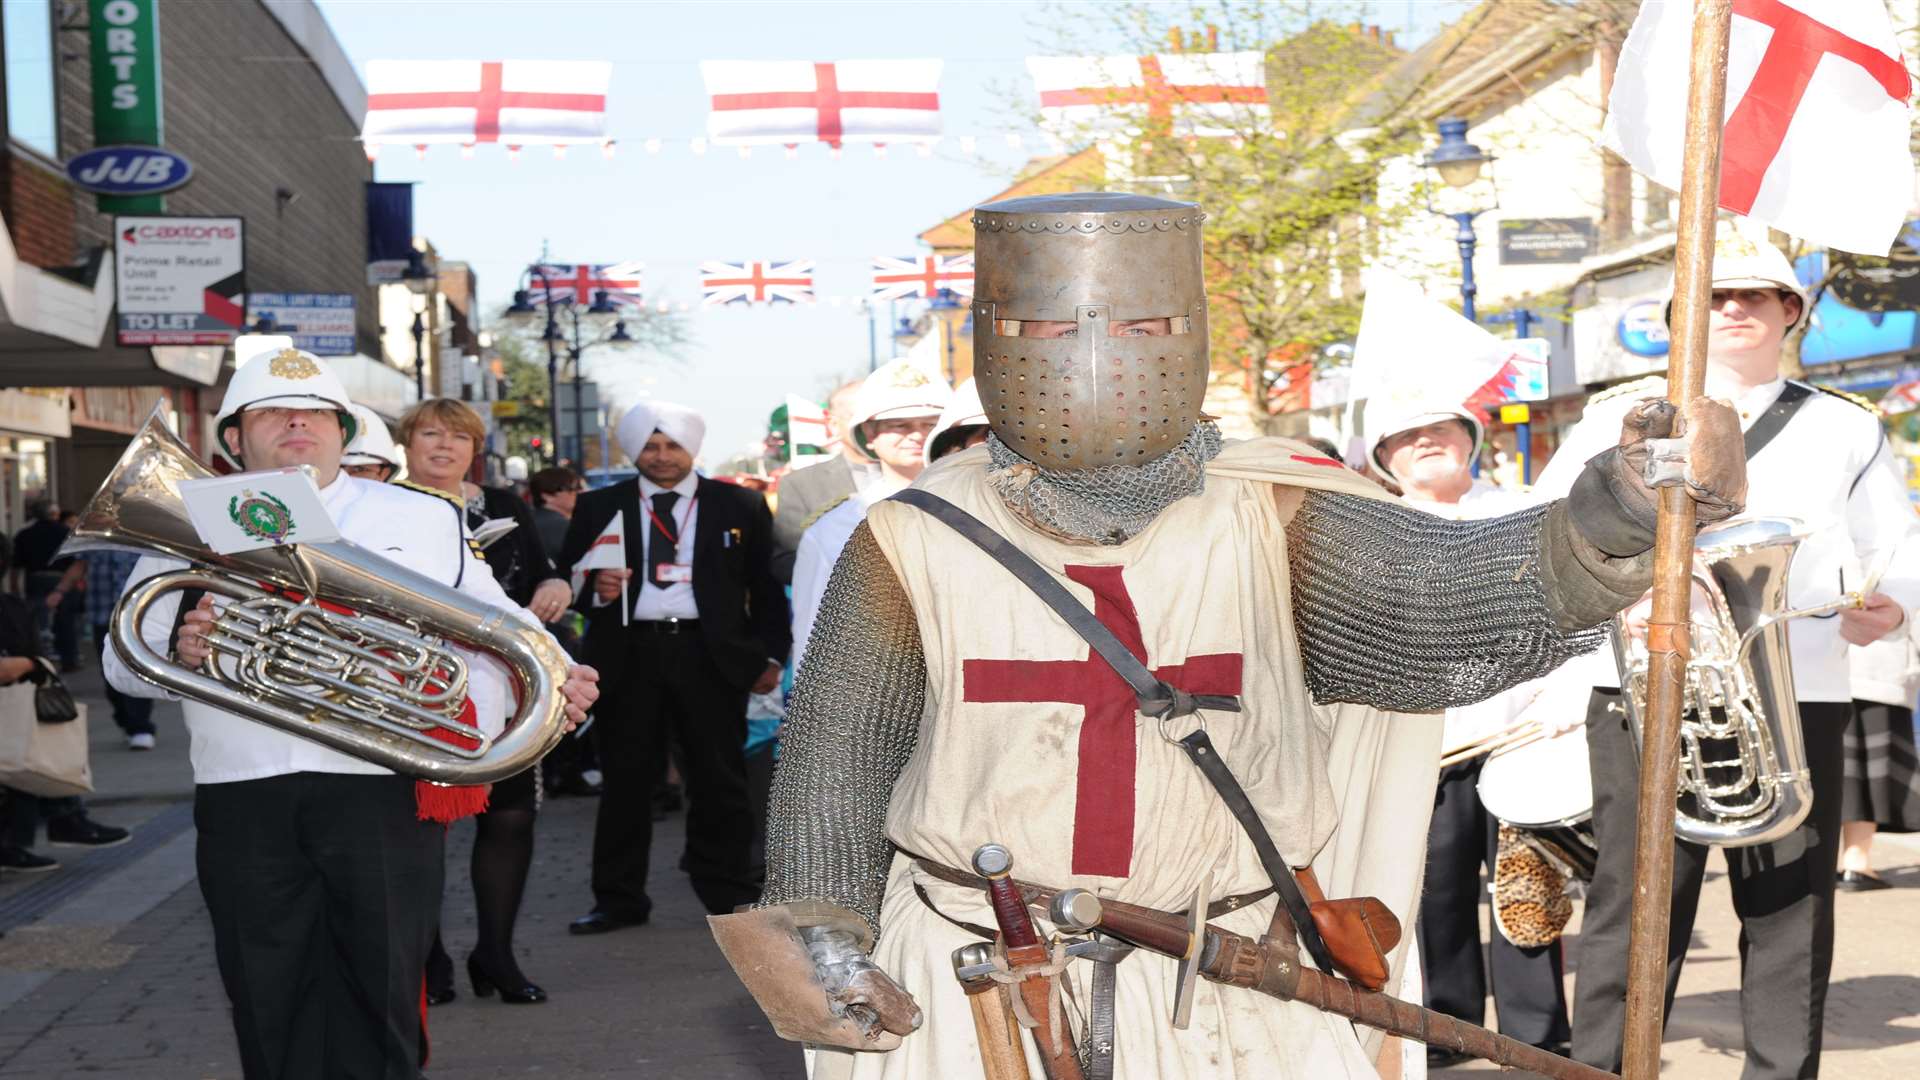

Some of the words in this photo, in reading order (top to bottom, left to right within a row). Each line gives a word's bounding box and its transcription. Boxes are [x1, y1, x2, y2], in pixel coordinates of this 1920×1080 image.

[79, 155, 174, 184] JJB
[138, 225, 236, 240] caxtons
[124, 256, 170, 266] Prime
[175, 256, 221, 266] Retail
[124, 269, 157, 279] Unit
[125, 314, 155, 329] TO
[158, 314, 197, 329] LET
